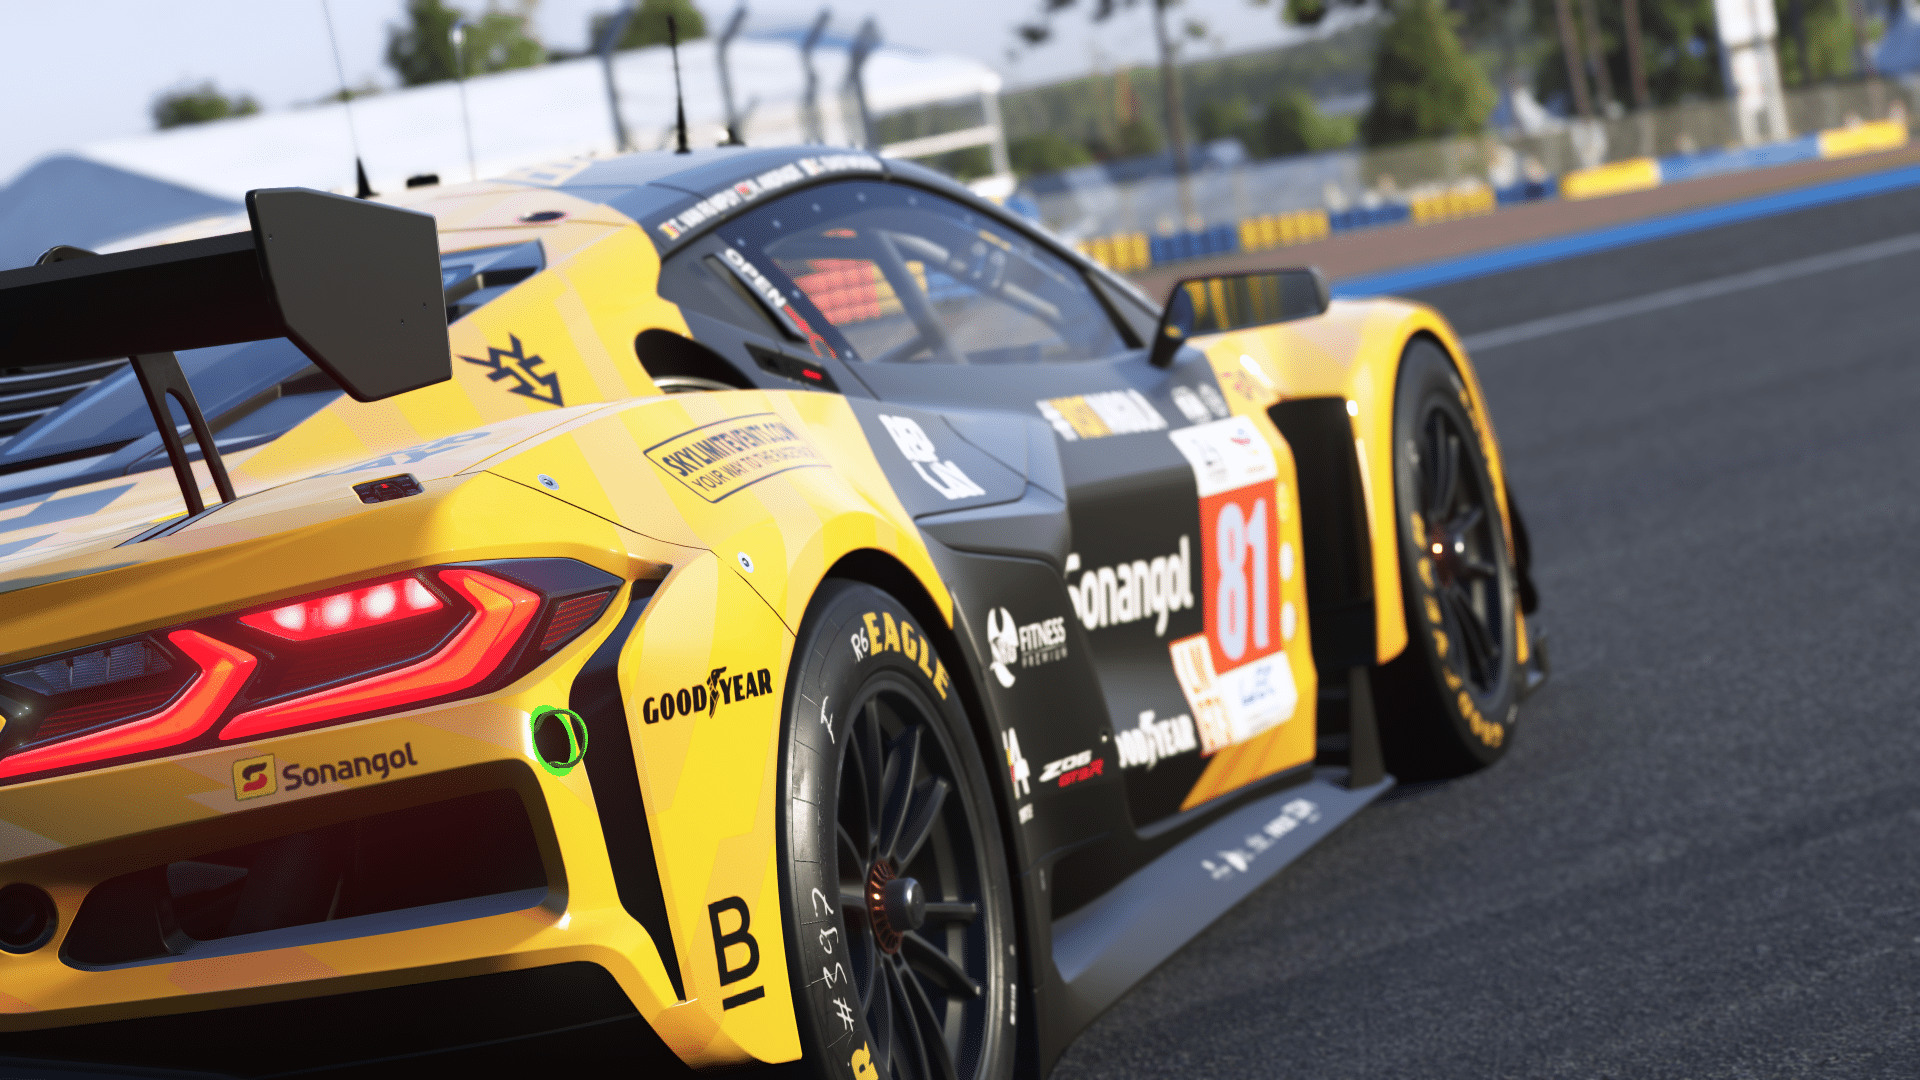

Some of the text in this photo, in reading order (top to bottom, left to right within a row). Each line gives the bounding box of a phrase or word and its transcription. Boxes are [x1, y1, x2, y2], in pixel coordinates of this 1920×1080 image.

[725, 248, 787, 308] OPEN
[691, 470, 731, 492] YOUR
[719, 460, 750, 478] WAY
[740, 456, 763, 468] TO
[1216, 497, 1271, 662] 81
[850, 626, 869, 662] R6
[862, 611, 950, 701] EAGLE
[1018, 616, 1067, 652] FITNESS
[642, 666, 773, 725] GOODYEAR
[282, 742, 418, 792] Sonangol
[708, 895, 760, 987] B
